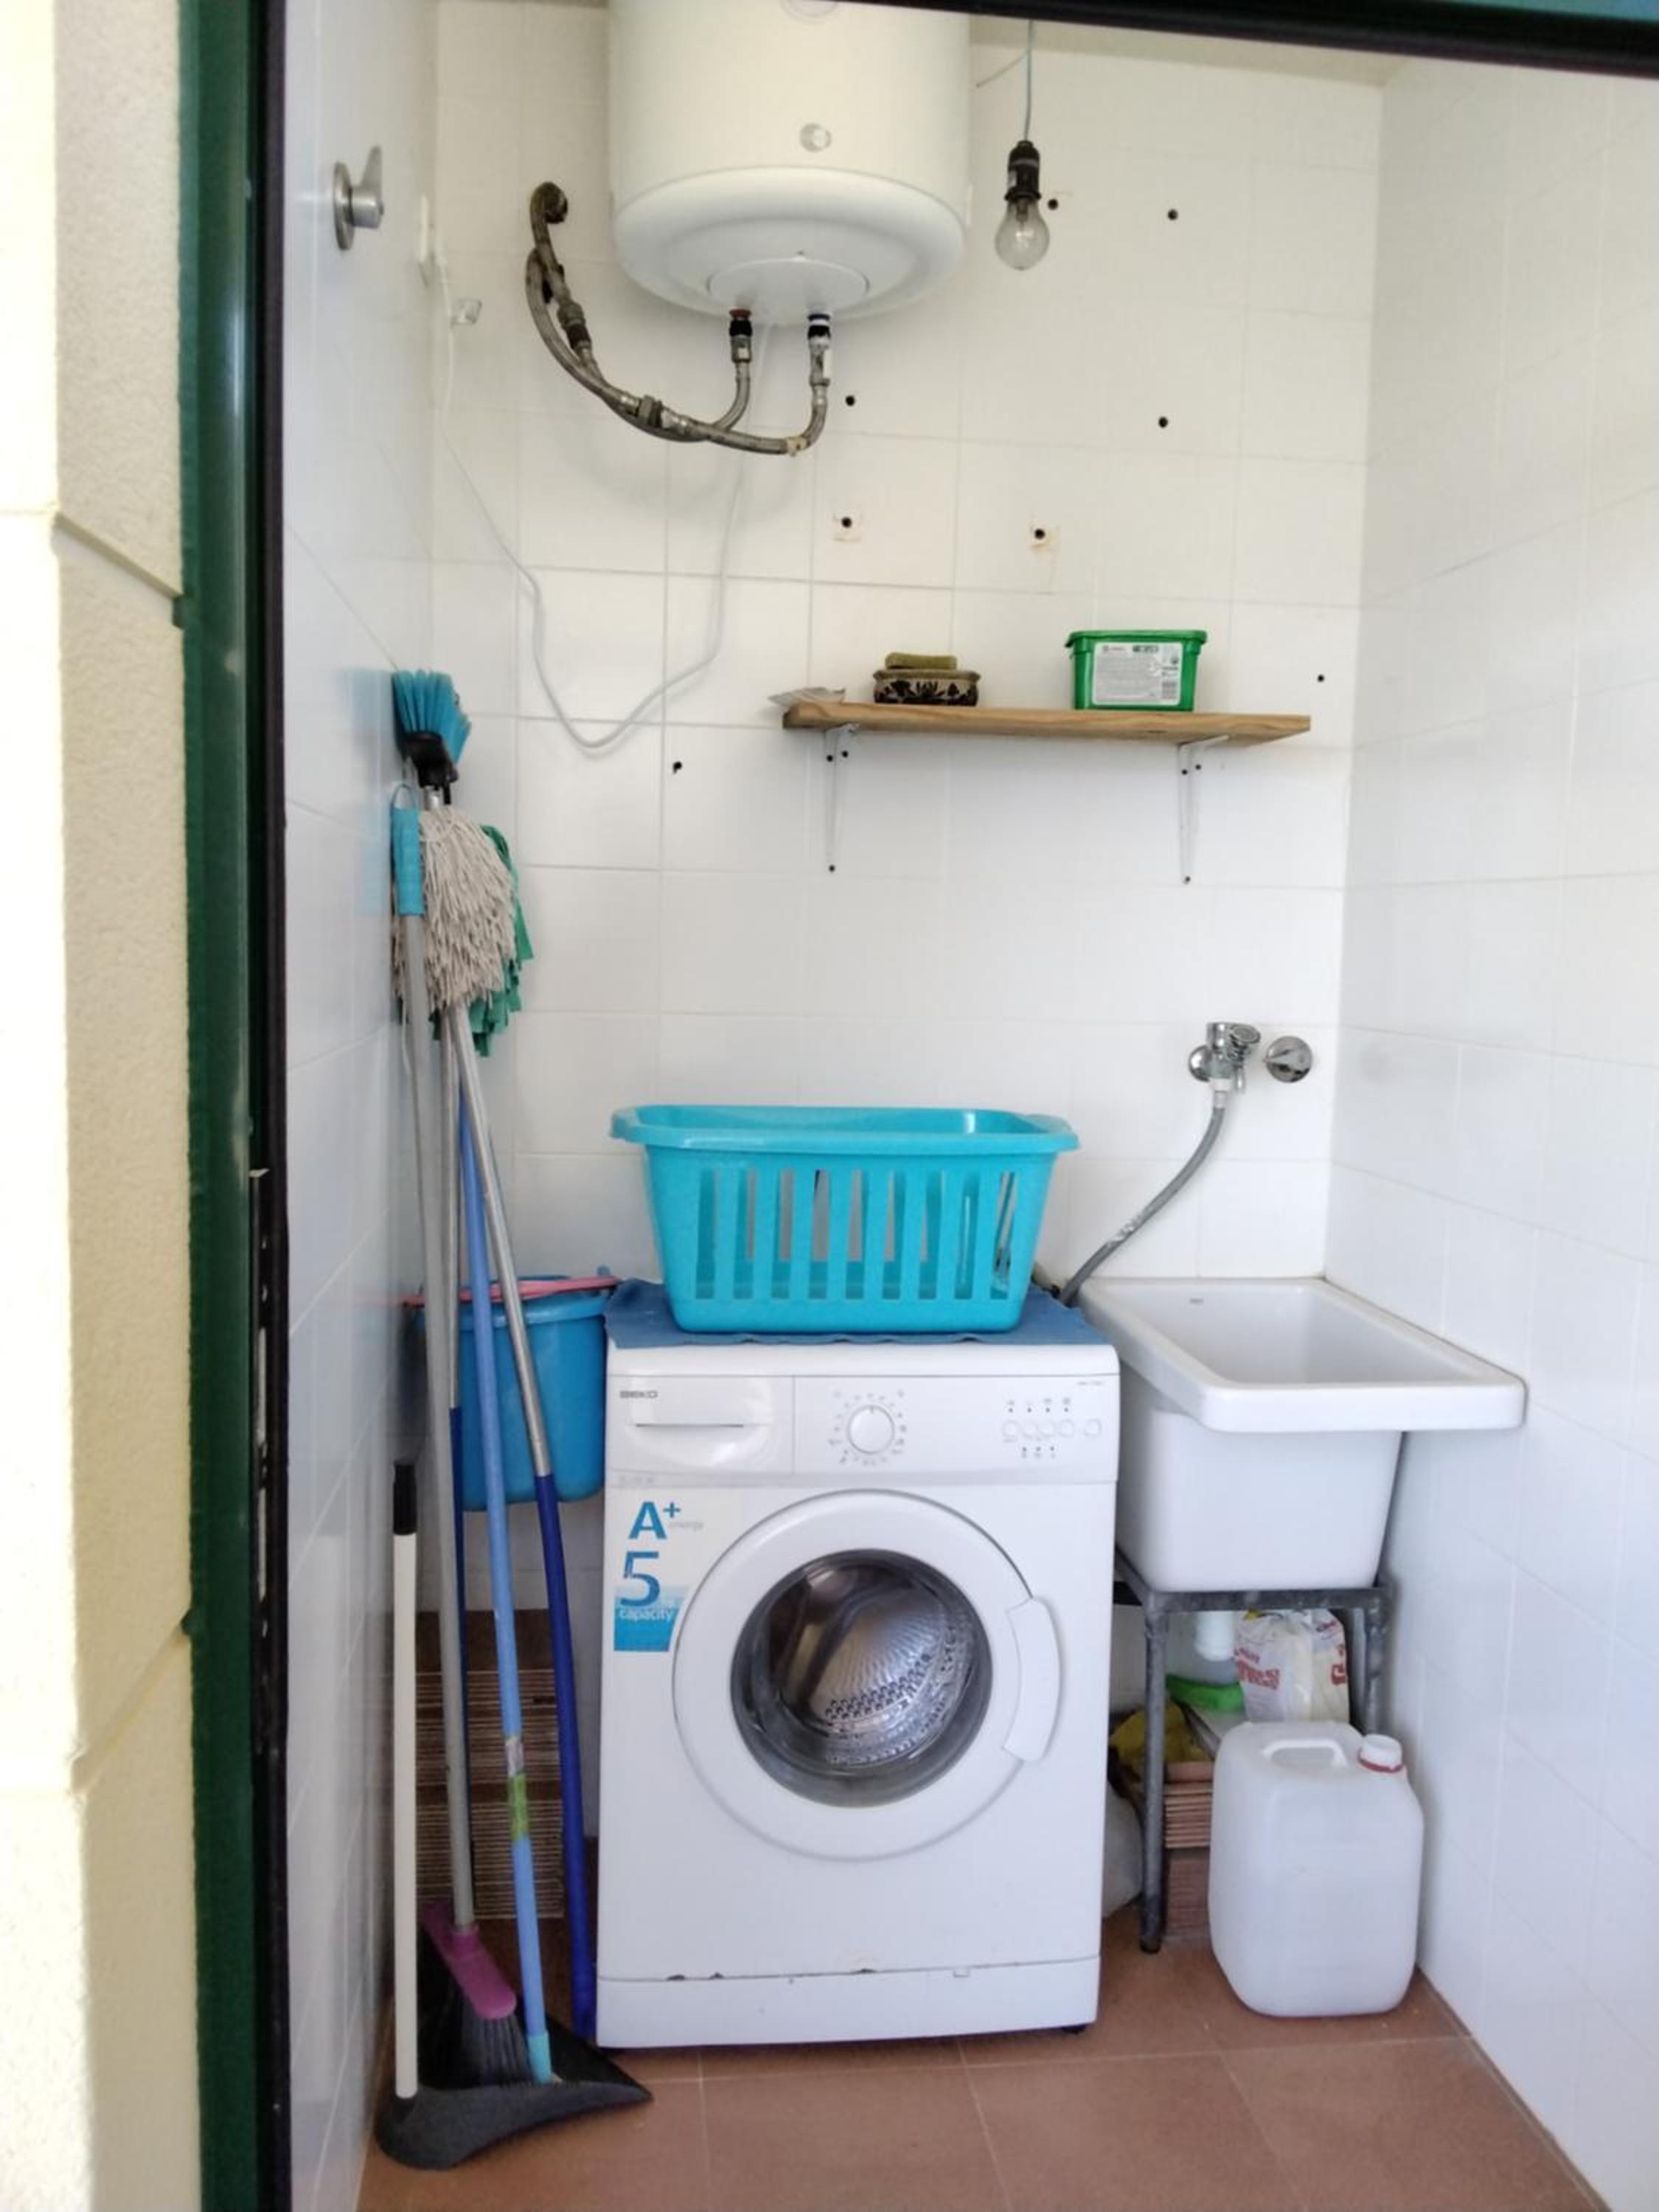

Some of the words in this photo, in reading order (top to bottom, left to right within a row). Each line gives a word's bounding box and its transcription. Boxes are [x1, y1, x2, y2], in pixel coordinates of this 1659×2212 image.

[628, 1500, 681, 1540] A+
[619, 1551, 661, 1607] 5
[618, 1605, 675, 1621] capacity
